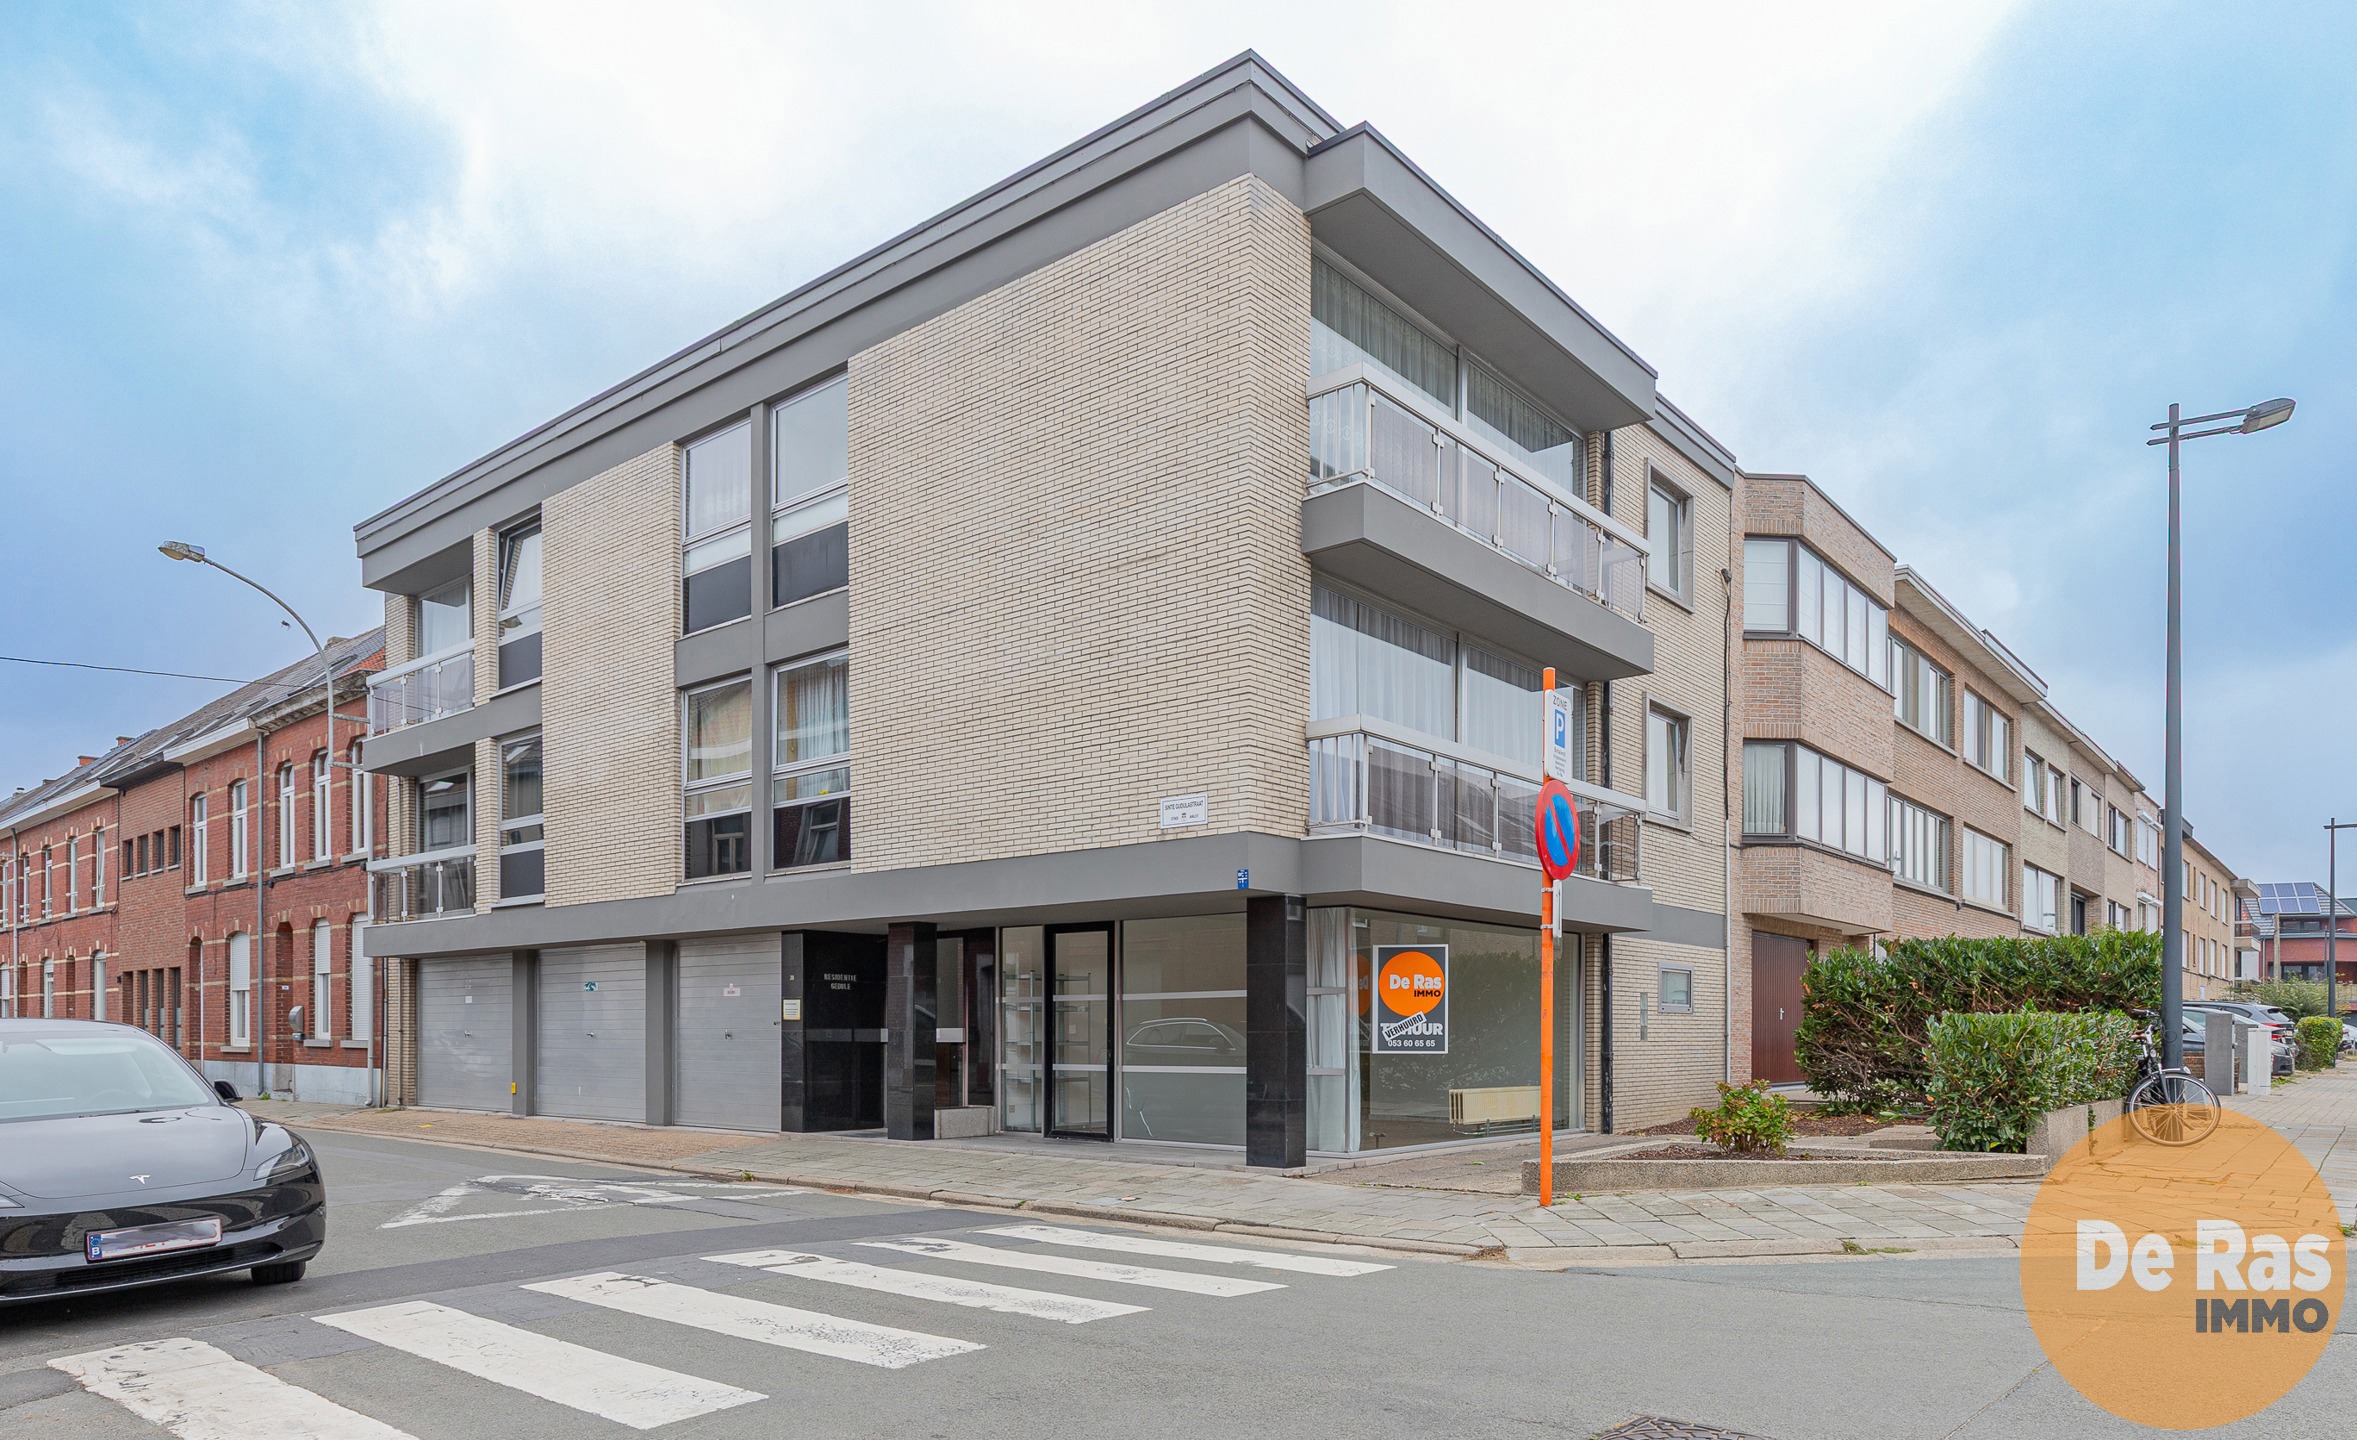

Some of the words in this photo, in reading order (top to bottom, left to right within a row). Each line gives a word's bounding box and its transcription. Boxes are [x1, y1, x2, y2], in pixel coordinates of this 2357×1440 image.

[1552, 695, 1567, 711] ZONE
[1556, 712, 1564, 740] P
[823, 973, 857, 982] RESIDENTIE
[1389, 974, 1409, 989] De
[1413, 974, 1441, 989] Ras
[1385, 1013, 1424, 1038] VERHUURD
[91, 1246, 100, 1256] B
